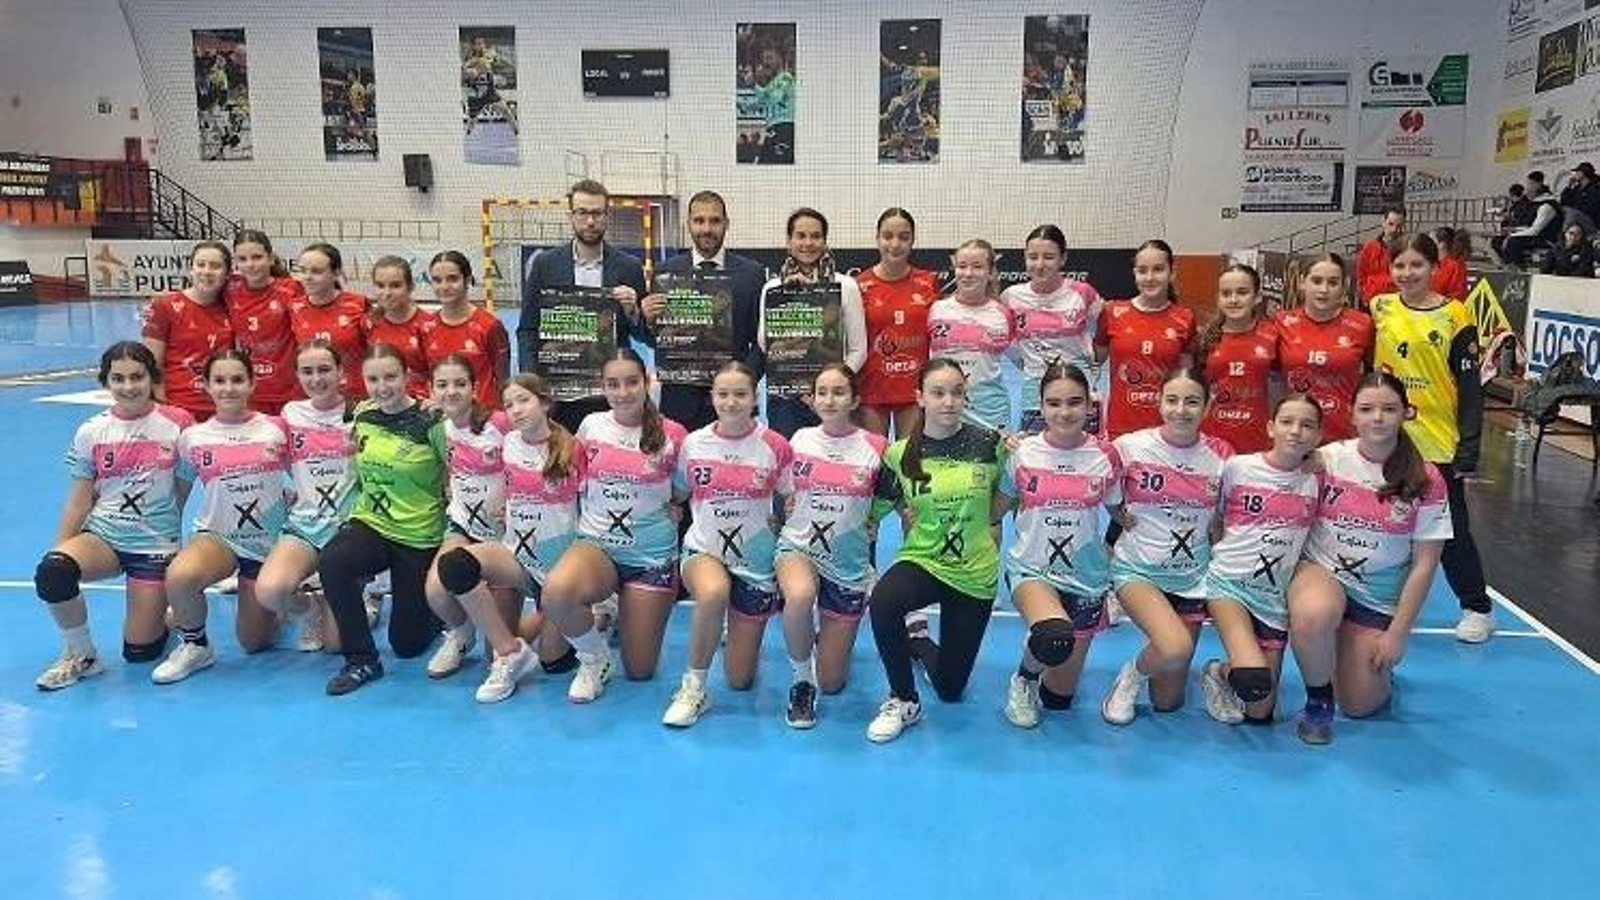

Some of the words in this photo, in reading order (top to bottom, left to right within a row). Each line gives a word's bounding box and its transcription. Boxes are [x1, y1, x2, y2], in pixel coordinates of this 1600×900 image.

[1265, 110, 1332, 124] TALLERES
[247, 321, 258, 335] 3
[1141, 340, 1153, 355] 8
[1397, 342, 1408, 358] 4
[1306, 350, 1327, 365] 16
[1228, 361, 1246, 376] 12
[104, 452, 114, 468] 9
[203, 450, 214, 466] 8
[694, 467, 712, 485] 23
[1138, 471, 1164, 493] 30
[1243, 495, 1264, 513] 18
